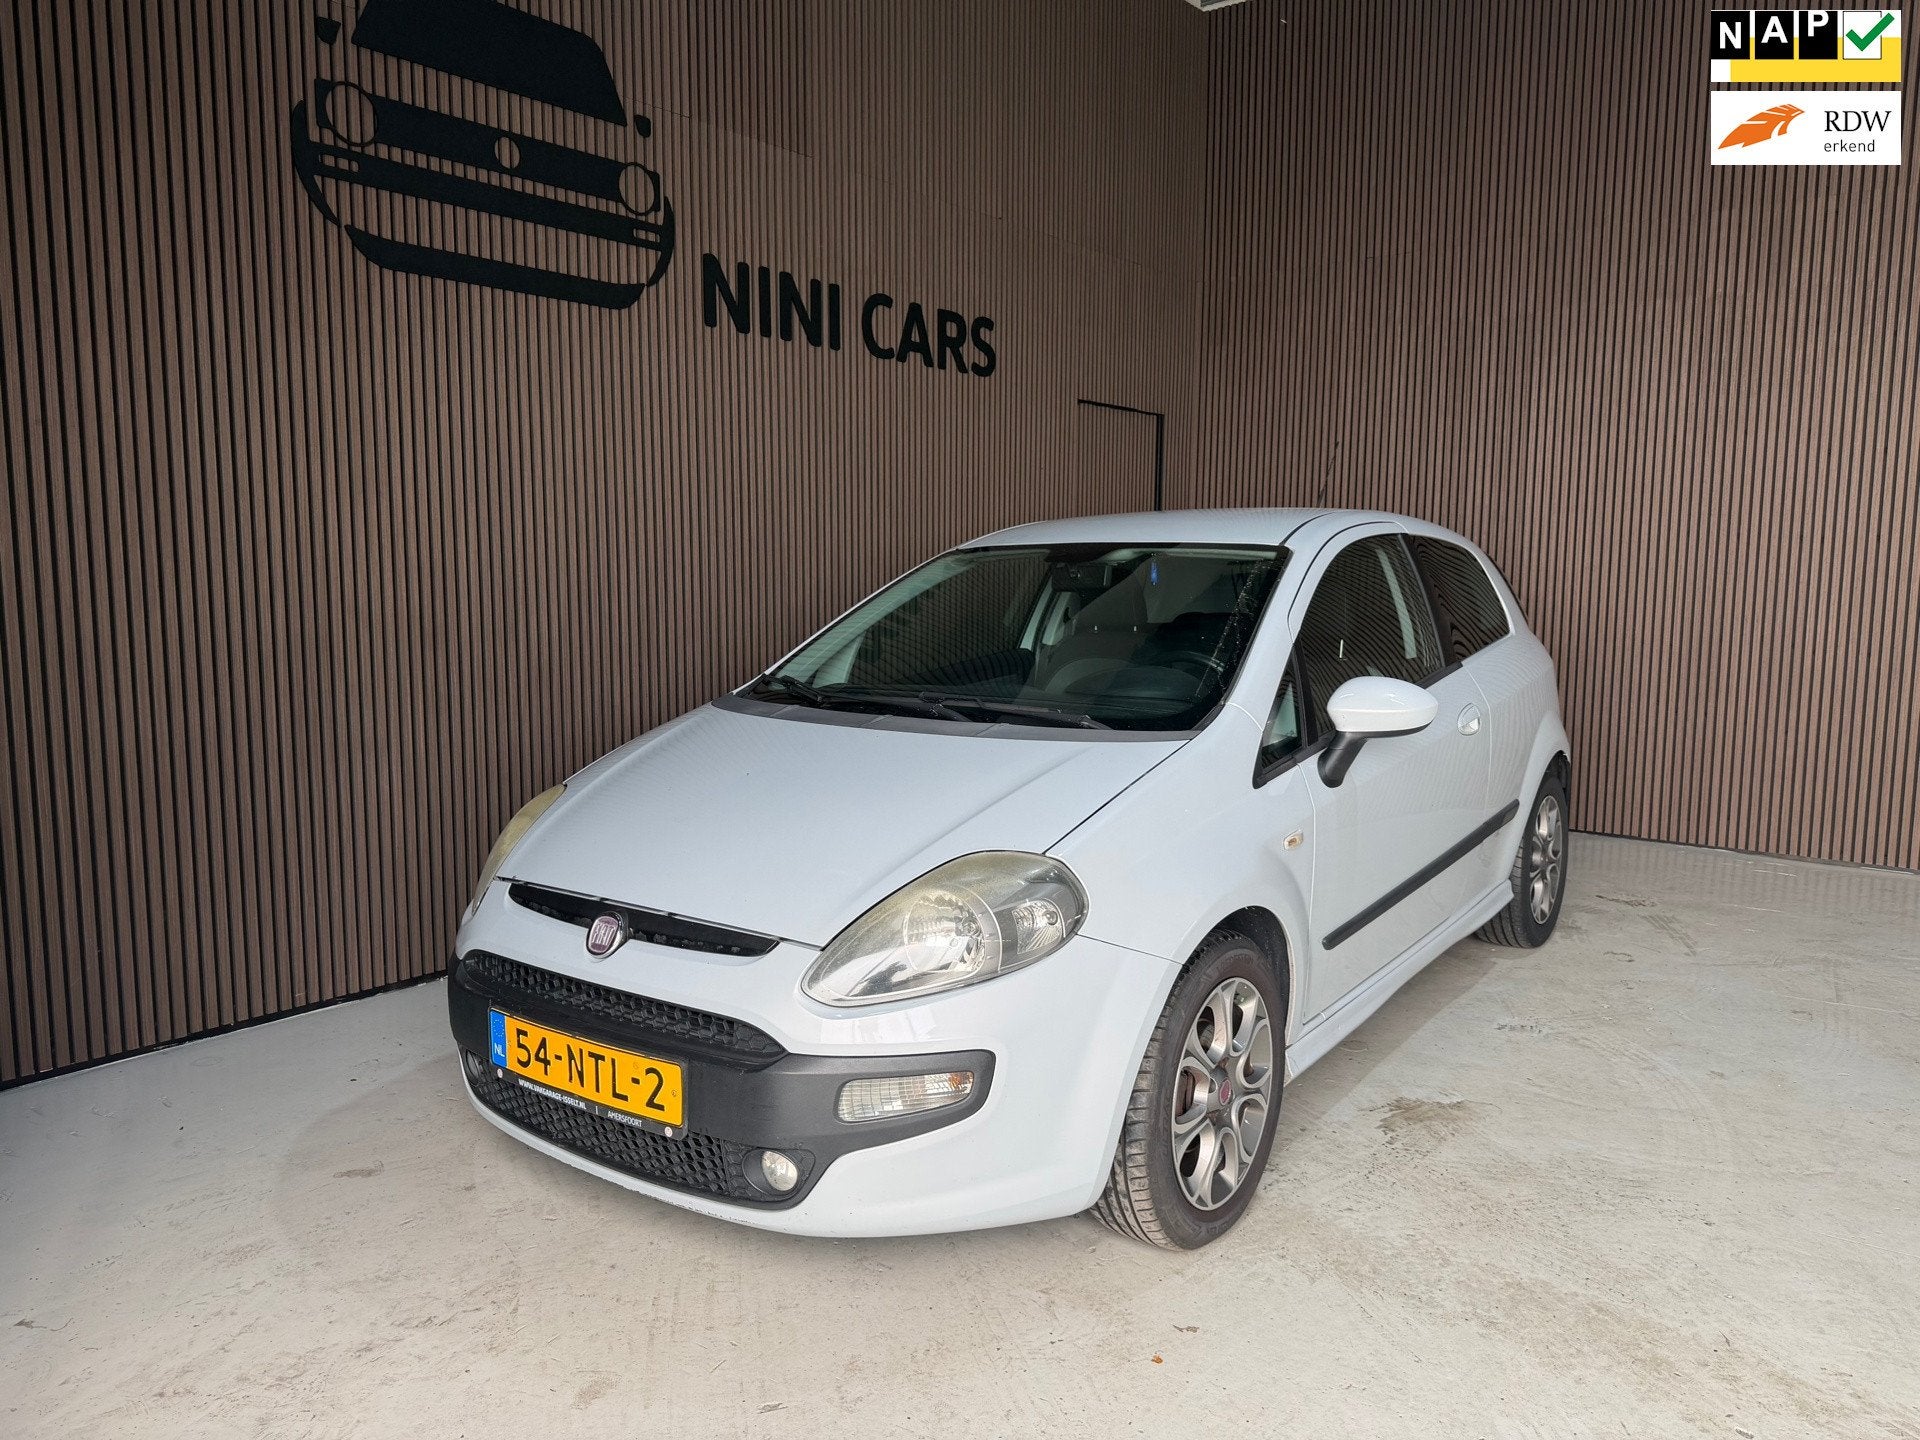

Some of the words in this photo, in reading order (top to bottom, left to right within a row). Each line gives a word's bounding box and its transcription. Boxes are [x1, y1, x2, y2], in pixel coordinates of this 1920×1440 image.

[703, 252, 841, 351] NINI
[861, 292, 997, 377] CARS
[494, 1043, 506, 1057] NL
[515, 1027, 666, 1112] 54-NTL-2
[607, 1110, 643, 1128] AMERSFOORT
